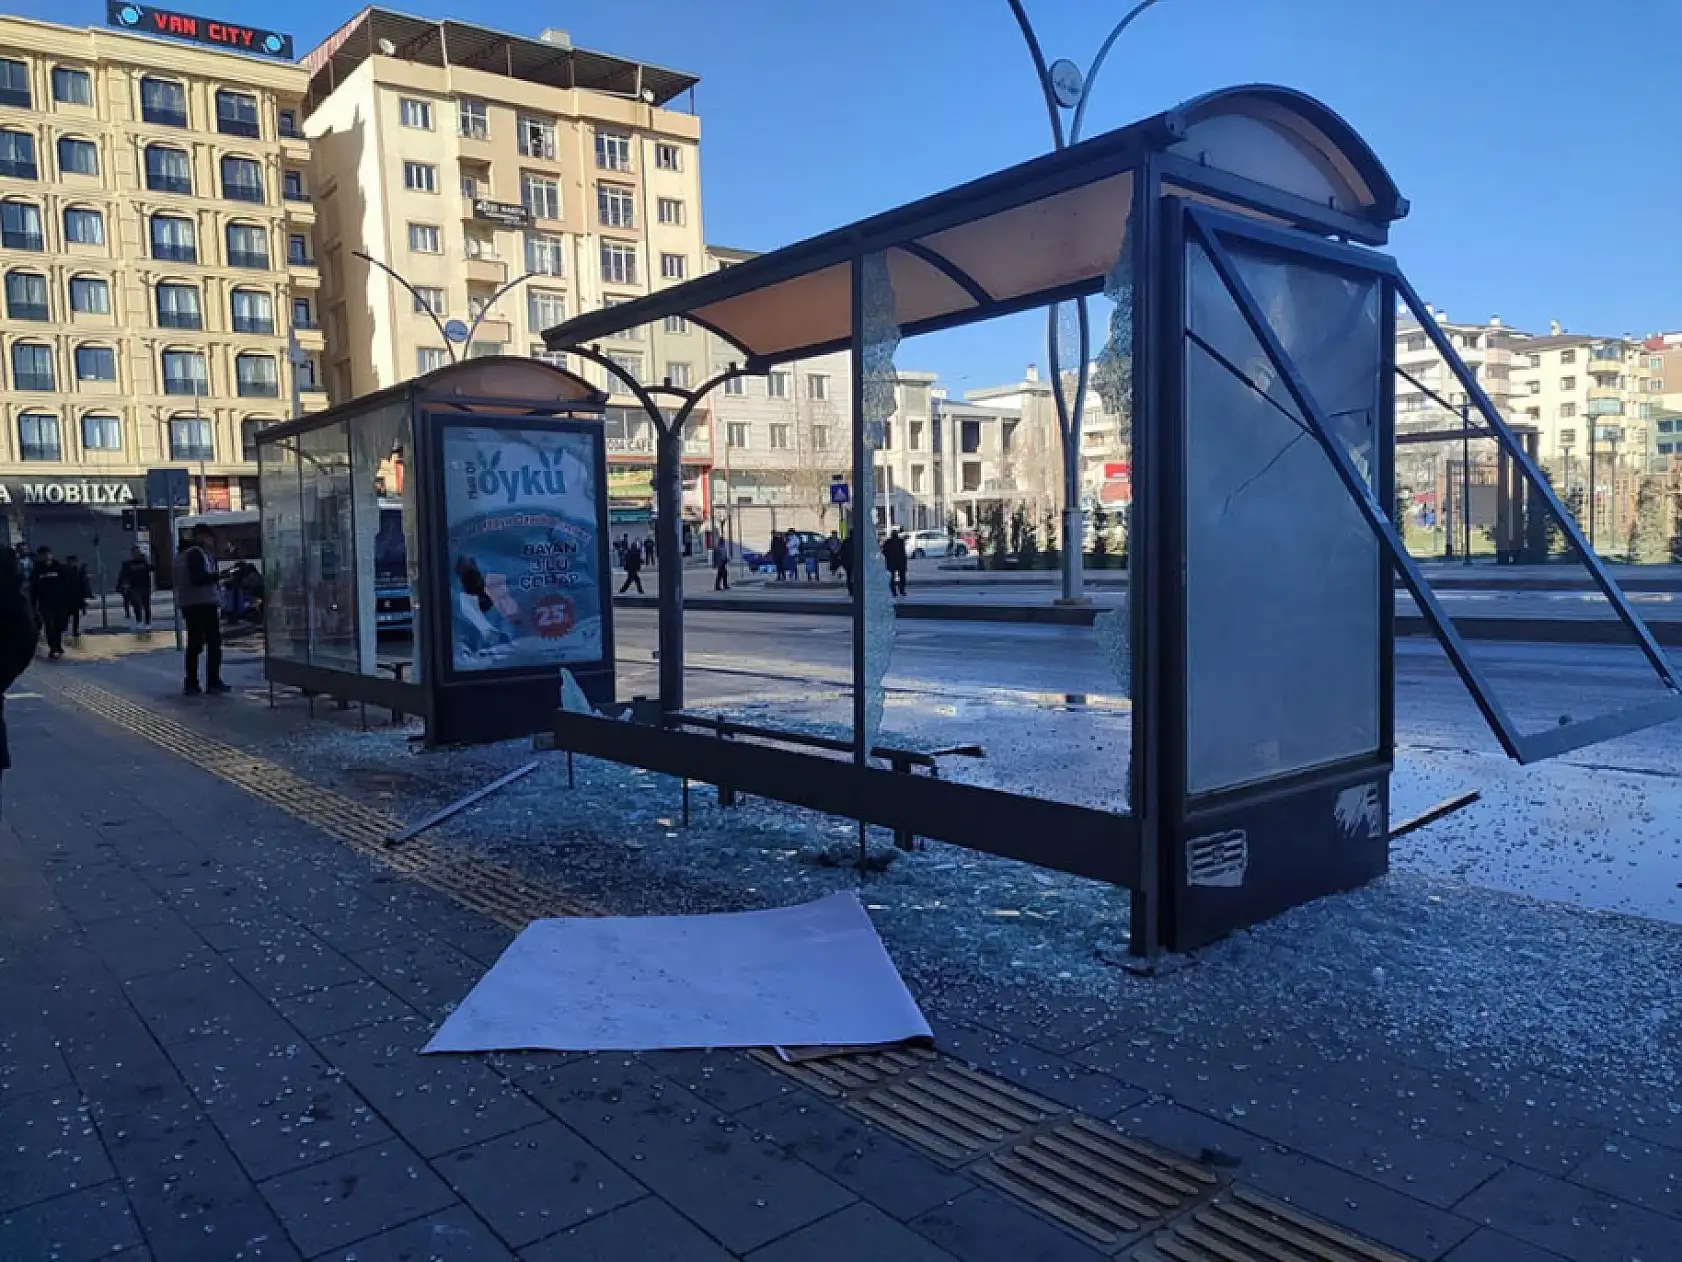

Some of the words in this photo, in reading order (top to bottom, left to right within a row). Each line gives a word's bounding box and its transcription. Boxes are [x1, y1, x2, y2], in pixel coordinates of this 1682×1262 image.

[153, 12, 196, 36] VAN
[208, 23, 254, 46] CITY
[23, 479, 134, 503] MOBİLYA
